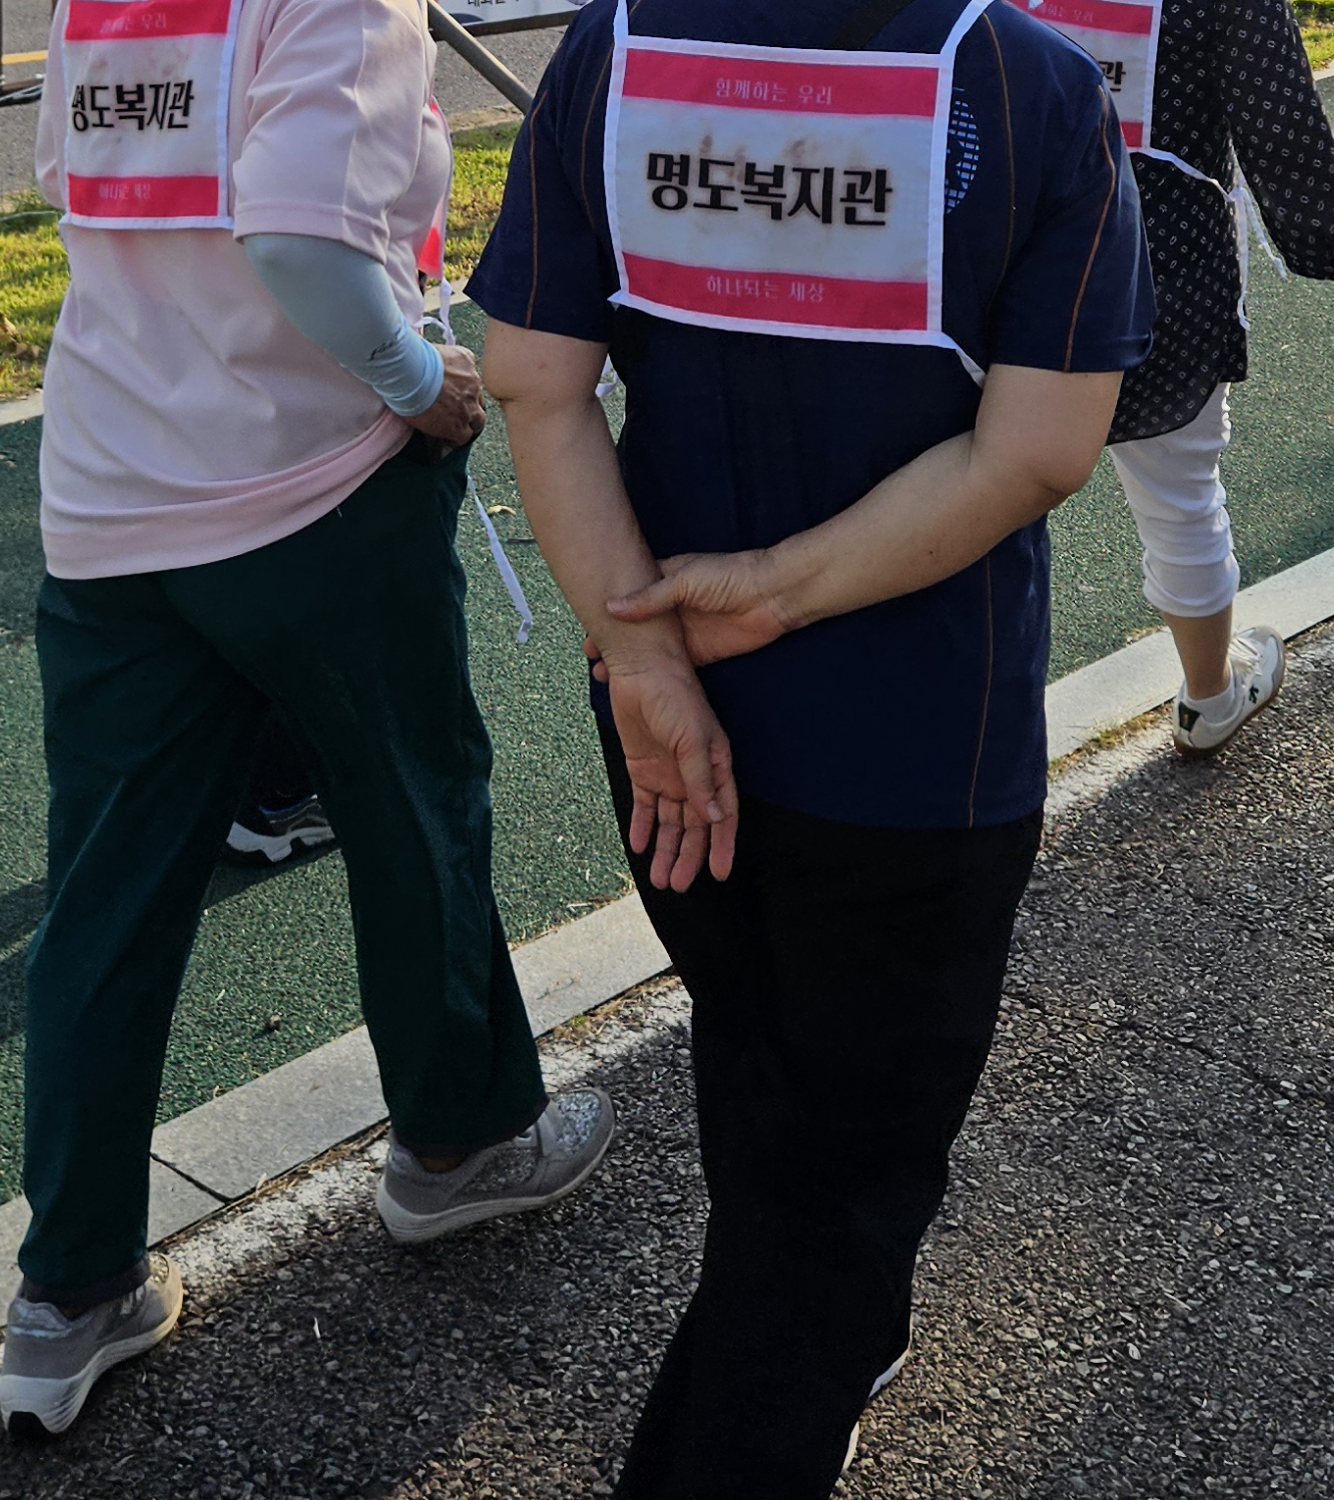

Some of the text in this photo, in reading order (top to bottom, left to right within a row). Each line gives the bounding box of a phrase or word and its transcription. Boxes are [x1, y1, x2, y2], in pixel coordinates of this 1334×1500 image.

[71, 79, 195, 132] 명도복지관
[715, 77, 833, 105] 함께하는 우리
[646, 152, 894, 227] 명도복지관
[707, 274, 825, 303] 하나되는 세상
